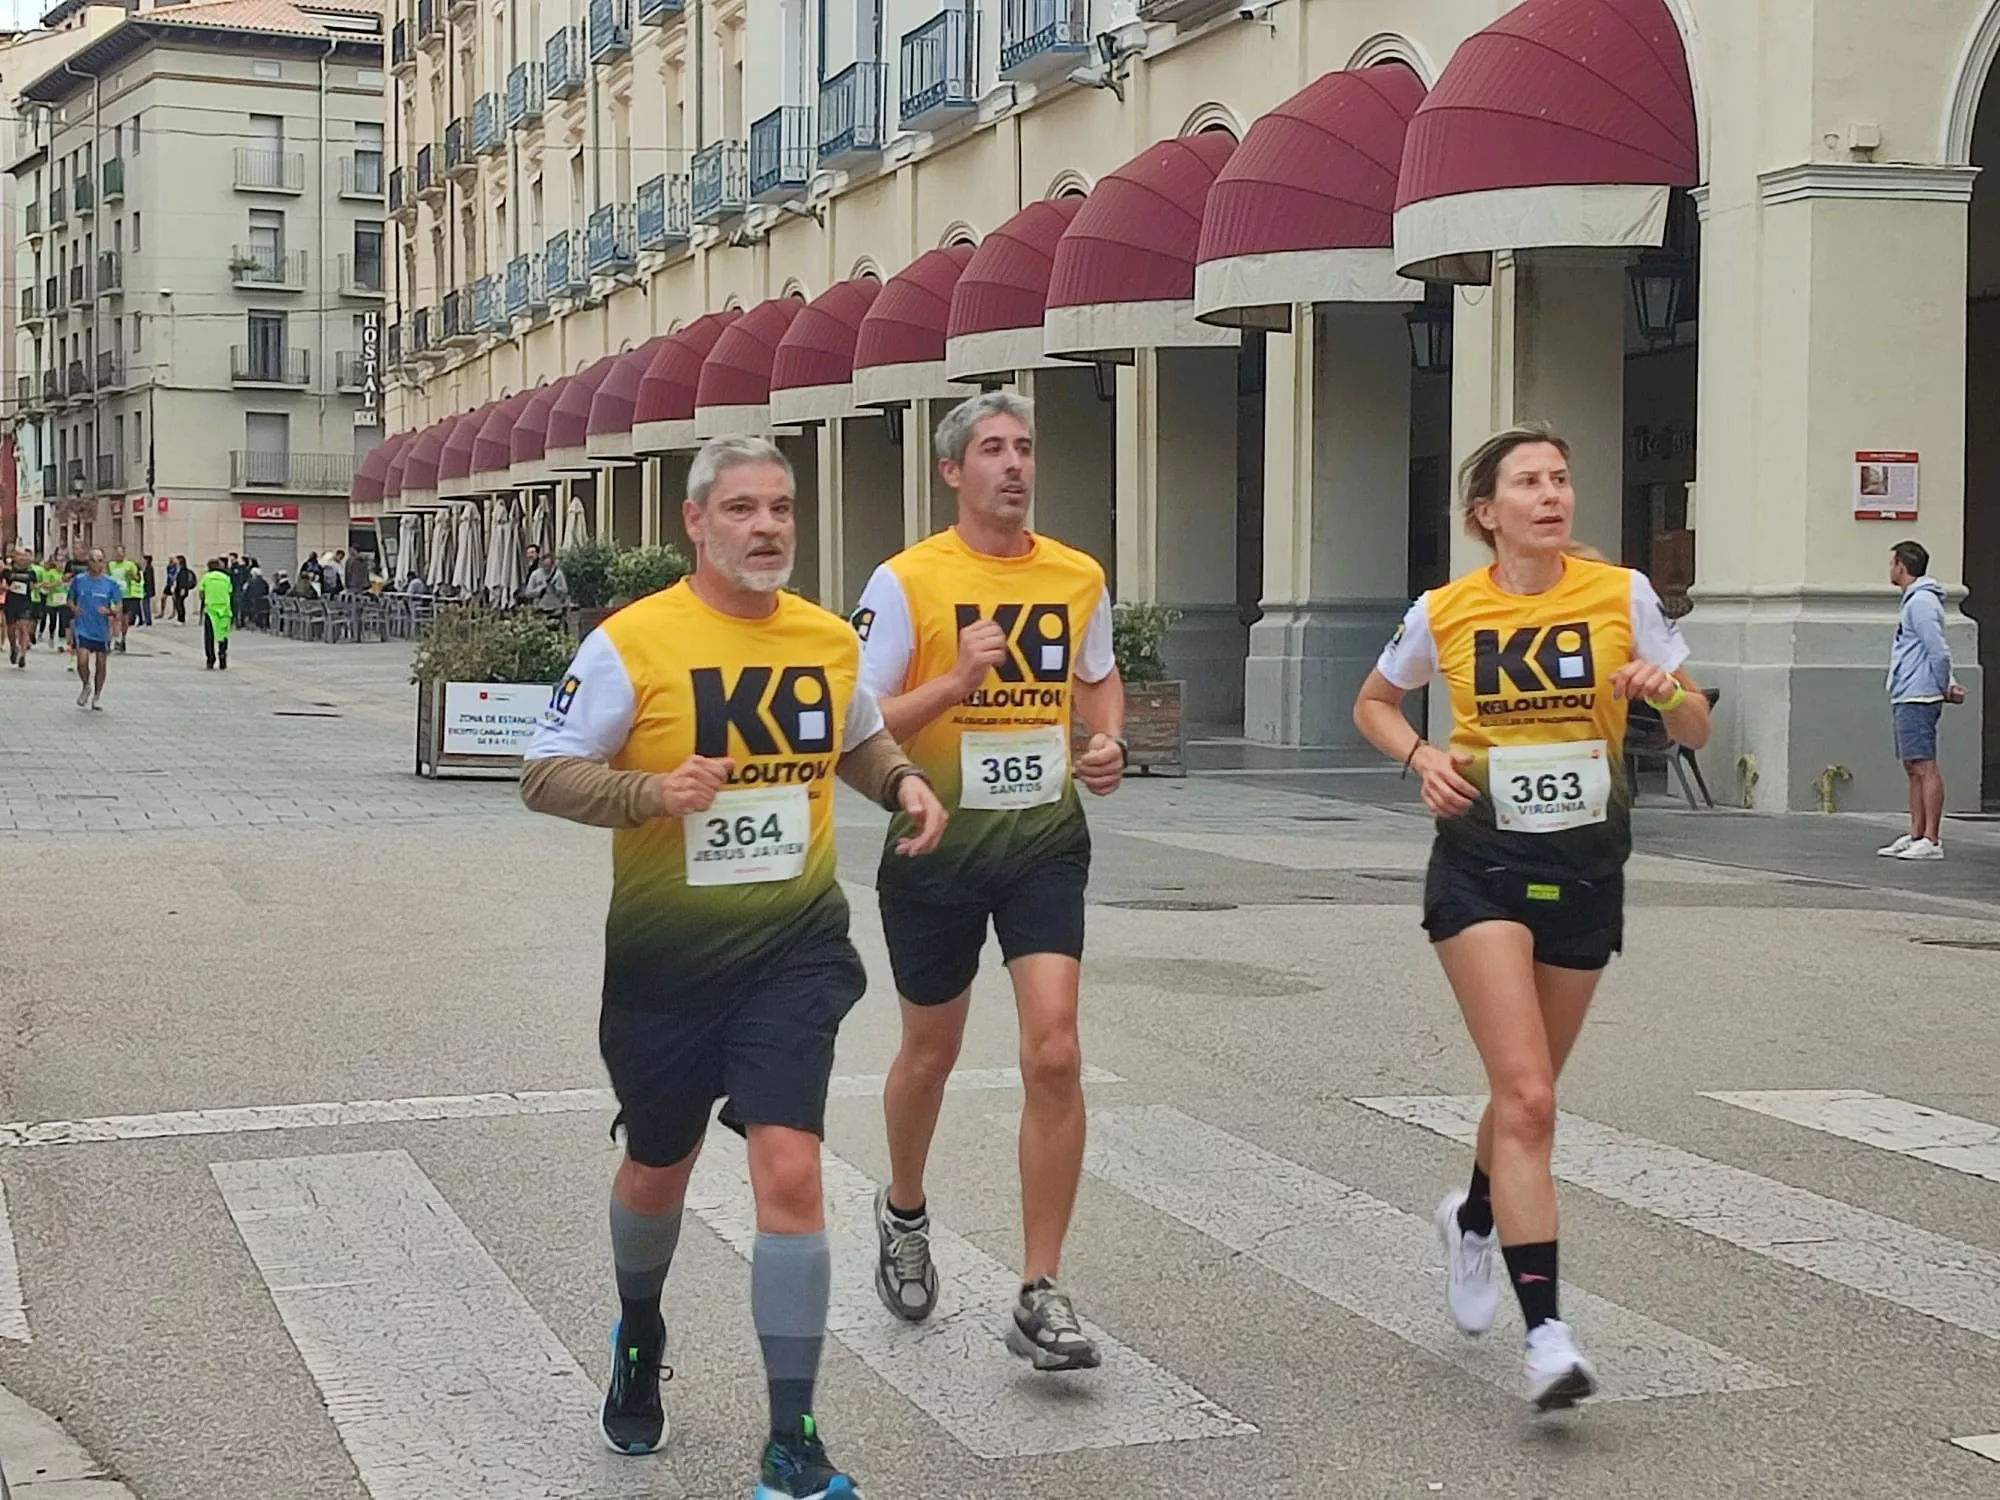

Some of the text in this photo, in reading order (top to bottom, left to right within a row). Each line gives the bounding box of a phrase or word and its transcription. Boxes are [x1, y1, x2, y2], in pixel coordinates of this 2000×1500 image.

[363, 312, 377, 408] HOSTAL
[726, 760, 832, 785] LOUTOU
[981, 754, 1043, 784] 365
[989, 782, 1043, 796] SANTOS
[1510, 772, 1583, 804] 363
[1517, 800, 1587, 817] VIRGINIA
[705, 812, 783, 848] 364
